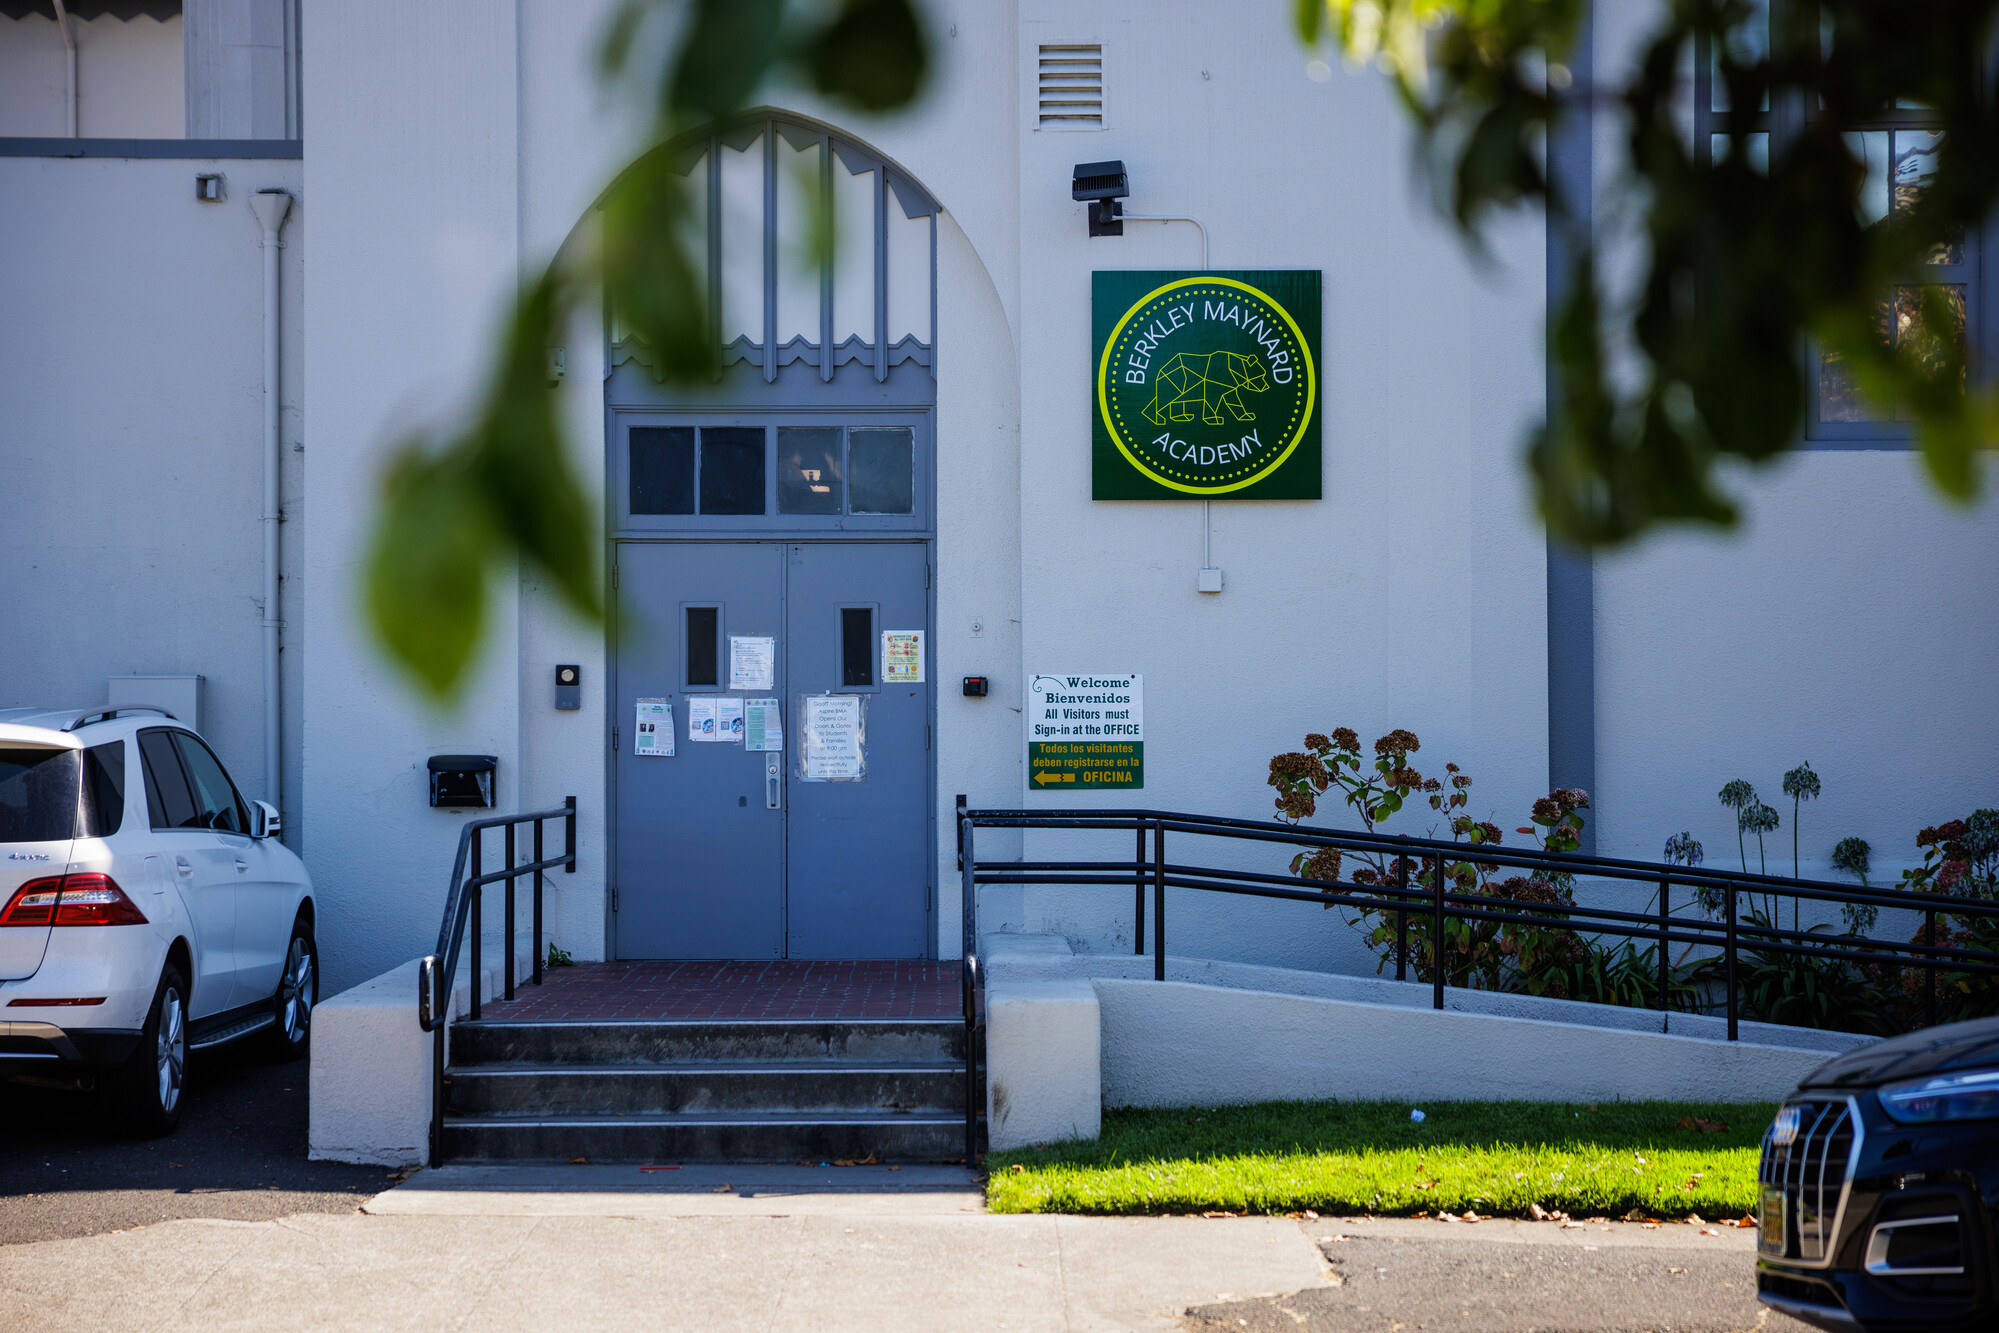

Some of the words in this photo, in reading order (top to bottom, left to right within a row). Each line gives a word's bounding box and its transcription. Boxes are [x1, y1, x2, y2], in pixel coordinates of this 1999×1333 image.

[1125, 302, 1194, 384] BERKLEY
[1204, 300, 1293, 385] MAYNARD
[1152, 428, 1263, 465] ACADEMY
[1066, 677, 1130, 688] Welcome
[1045, 692, 1131, 704] Bienvenidos
[1045, 708, 1058, 720] All
[1063, 708, 1101, 720] Visitors
[1105, 708, 1130, 720] must
[1034, 724, 1070, 738] Sign-in
[1072, 724, 1083, 735] at
[1085, 724, 1101, 735] the
[1103, 724, 1140, 735] OFFICE
[1040, 743, 1068, 753] Todos
[1070, 743, 1084, 753] los
[1086, 743, 1134, 753] visitantes
[1033, 757, 1061, 767] deben
[1064, 757, 1114, 769] registrarse
[1116, 759, 1128, 767] en
[1130, 757, 1140, 767] la
[1083, 771, 1133, 783] OFICINA
